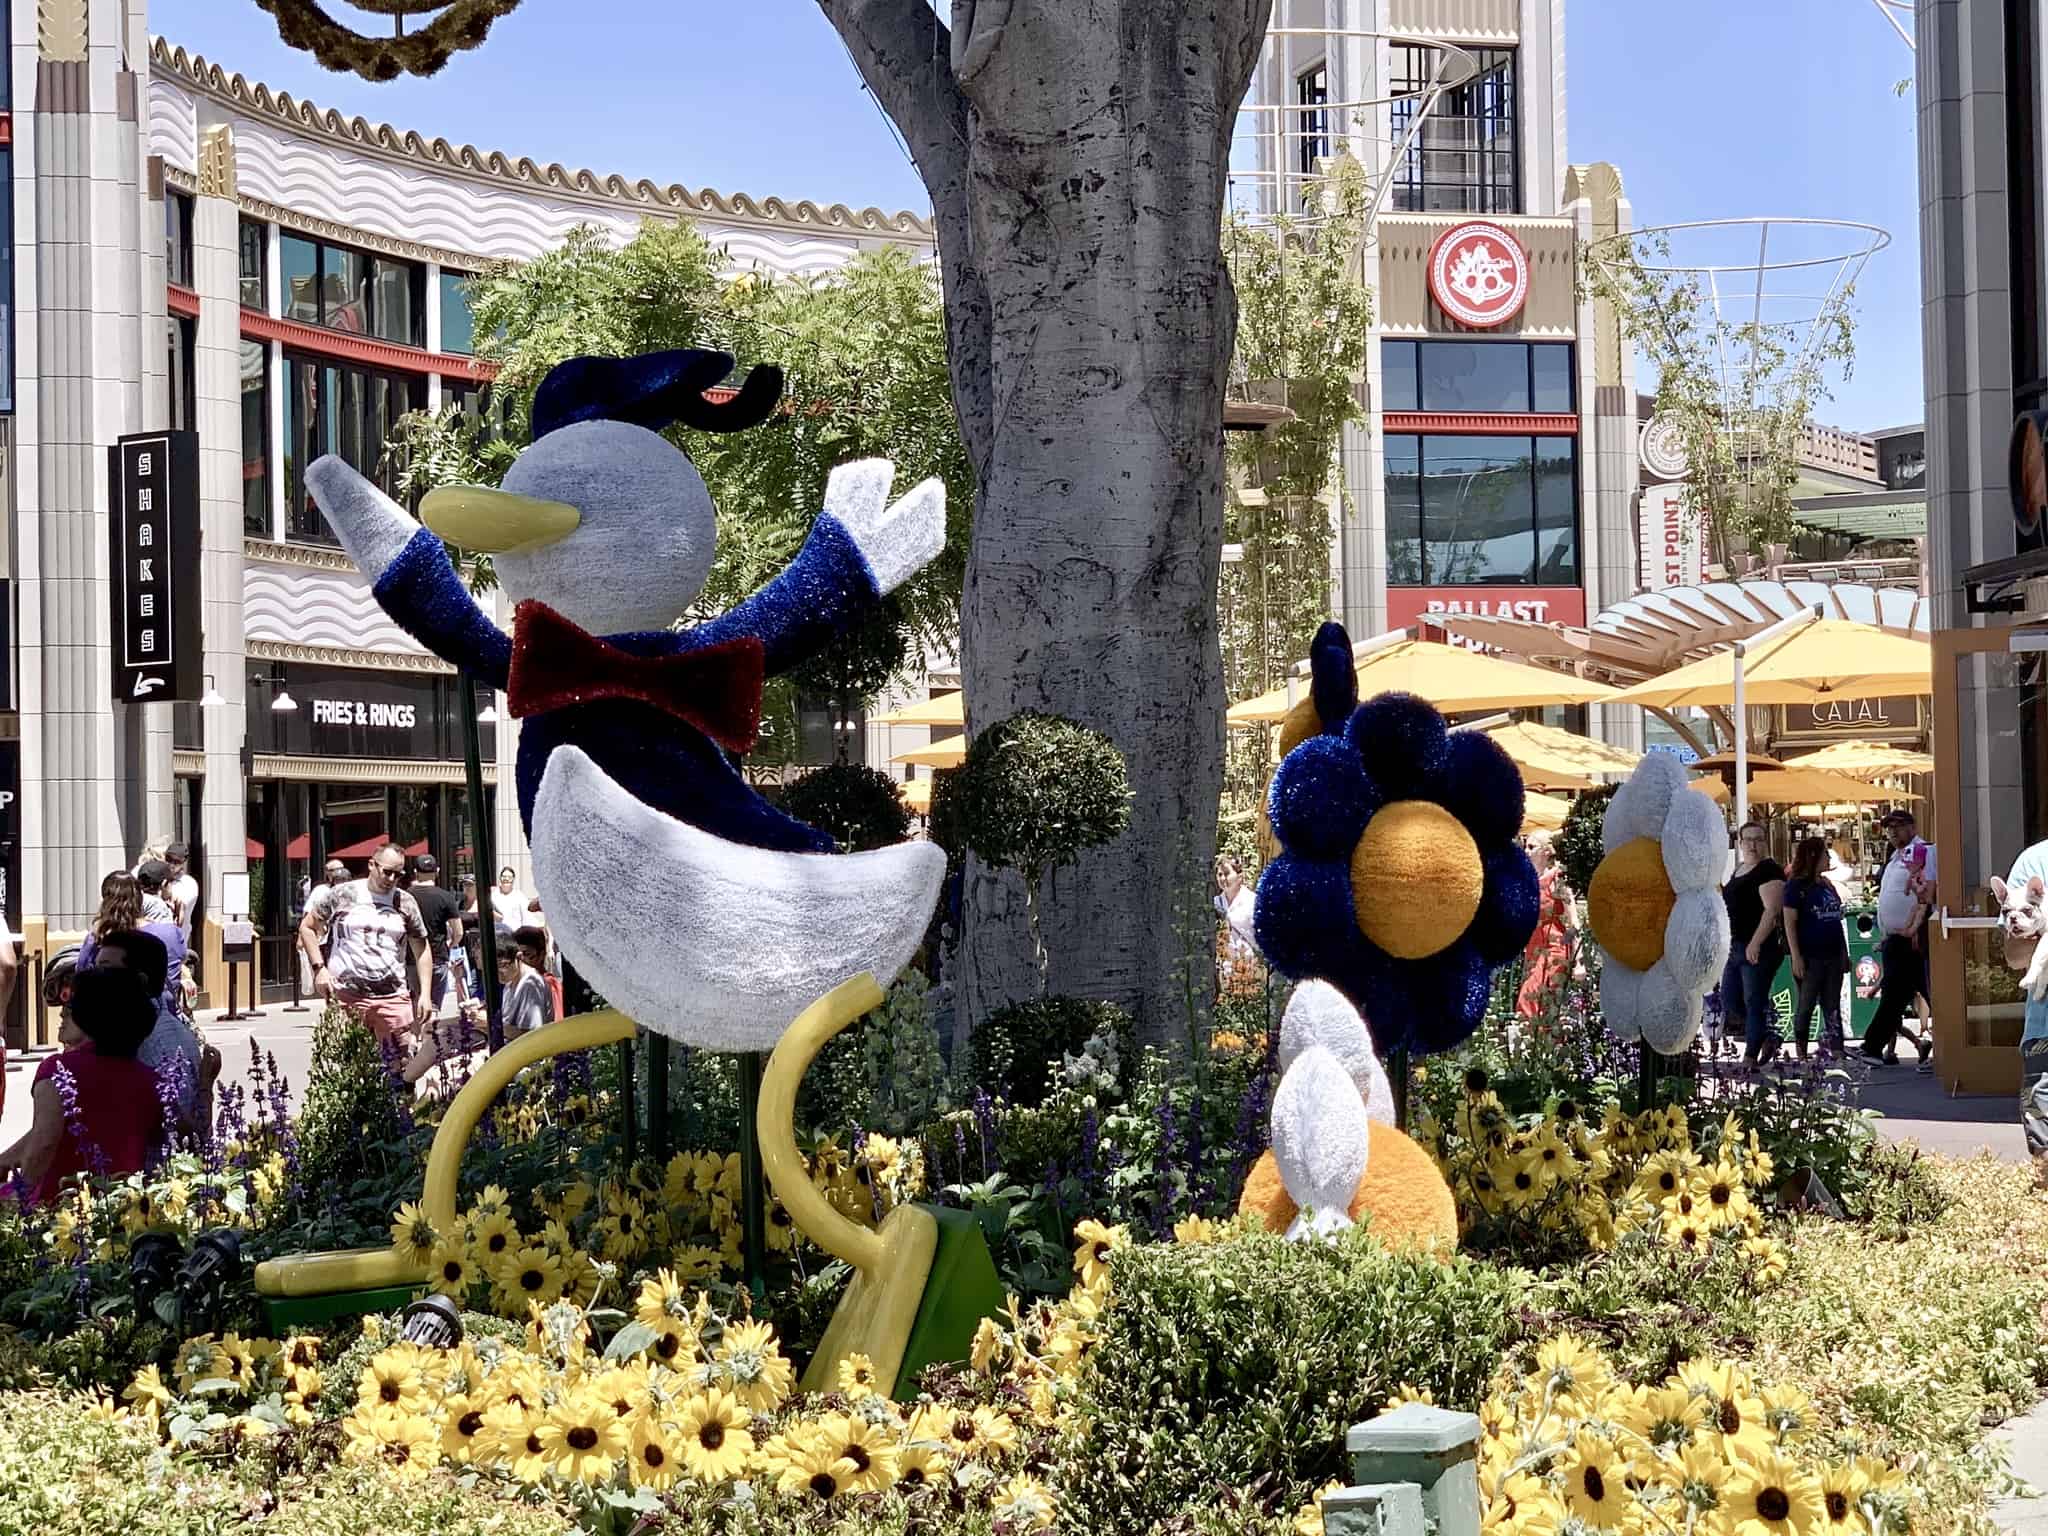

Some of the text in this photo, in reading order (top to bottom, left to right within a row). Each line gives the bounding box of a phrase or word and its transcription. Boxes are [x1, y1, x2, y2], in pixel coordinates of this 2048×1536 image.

[138, 452, 154, 652] SHAKES
[1664, 498, 1680, 557] POINT
[313, 700, 415, 728] FRIES & RINGS
